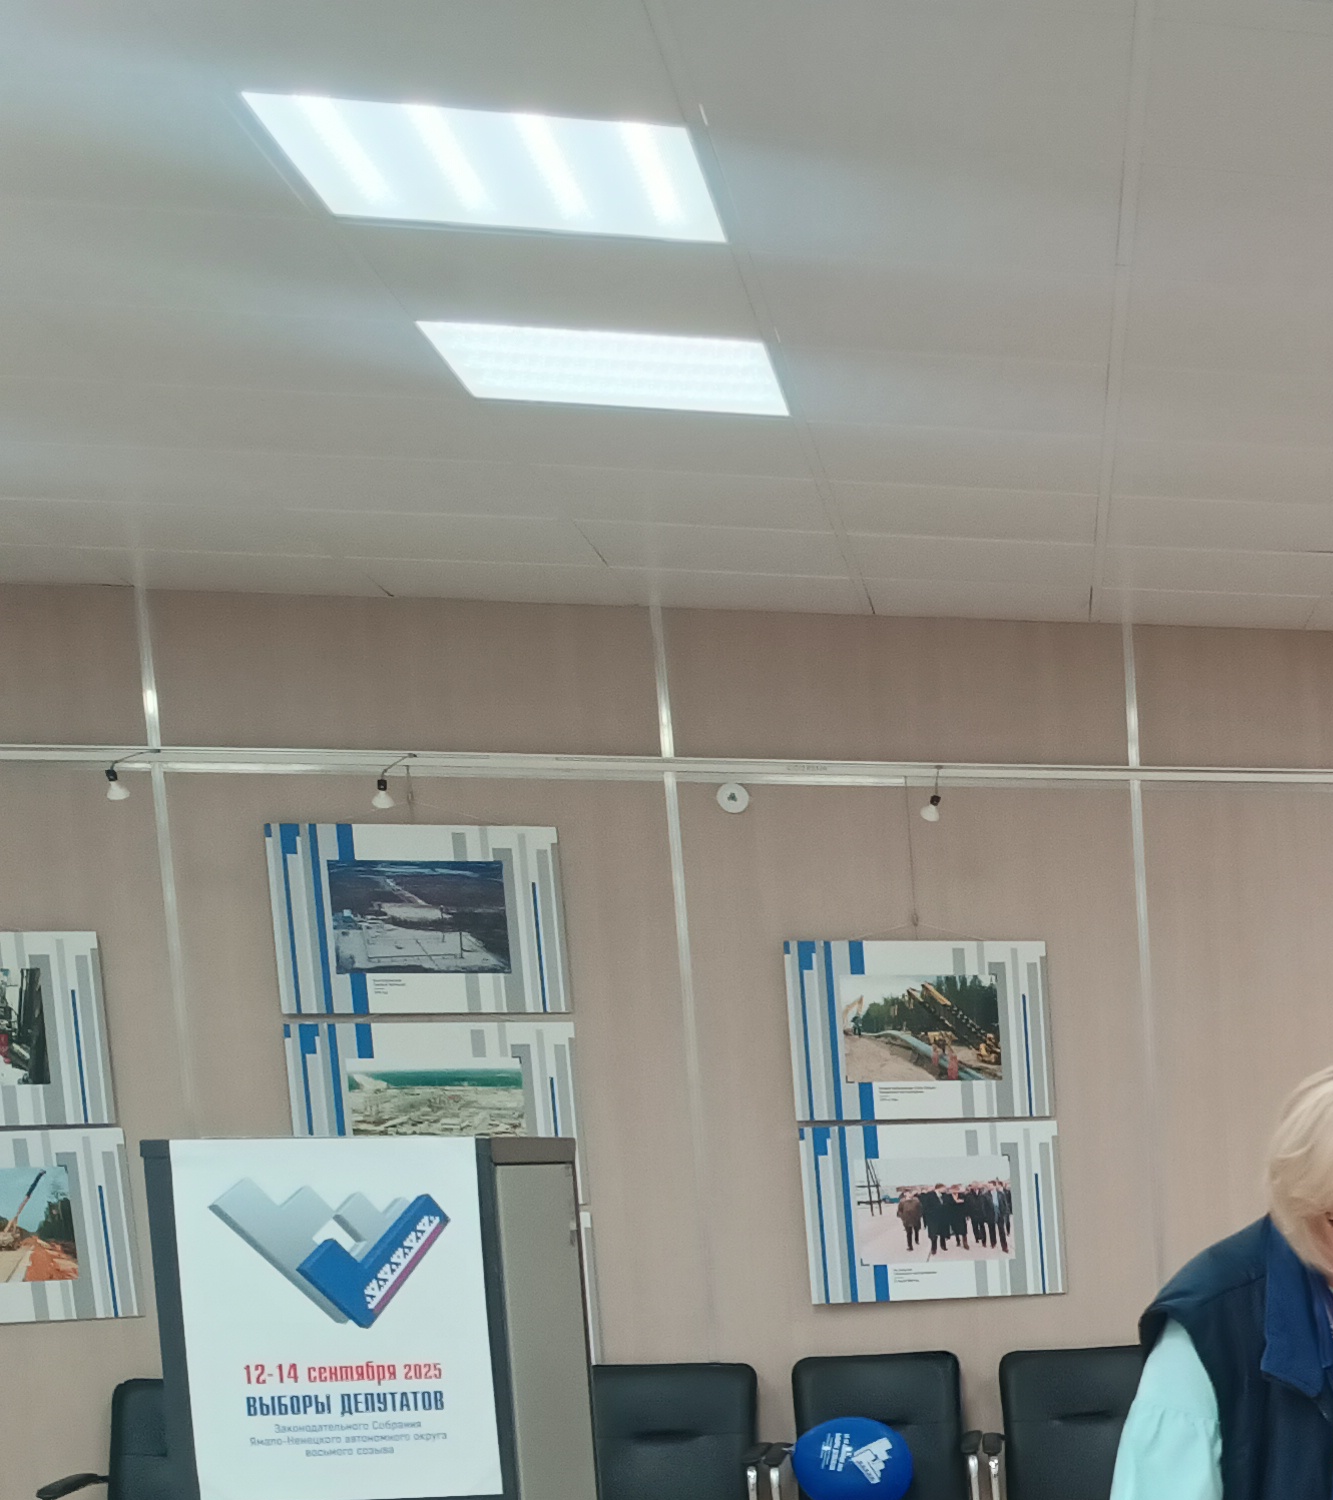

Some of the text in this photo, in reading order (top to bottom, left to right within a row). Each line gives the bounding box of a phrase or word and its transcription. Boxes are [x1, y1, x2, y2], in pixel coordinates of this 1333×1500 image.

[244, 1361, 443, 1386] 12-14 сентября 2025
[246, 1390, 445, 1418] ВЫБОРЫ ДЕПУТАТОВ
[274, 1420, 422, 1434] Законодательного Собрания
[413, 1432, 448, 1442] округа
